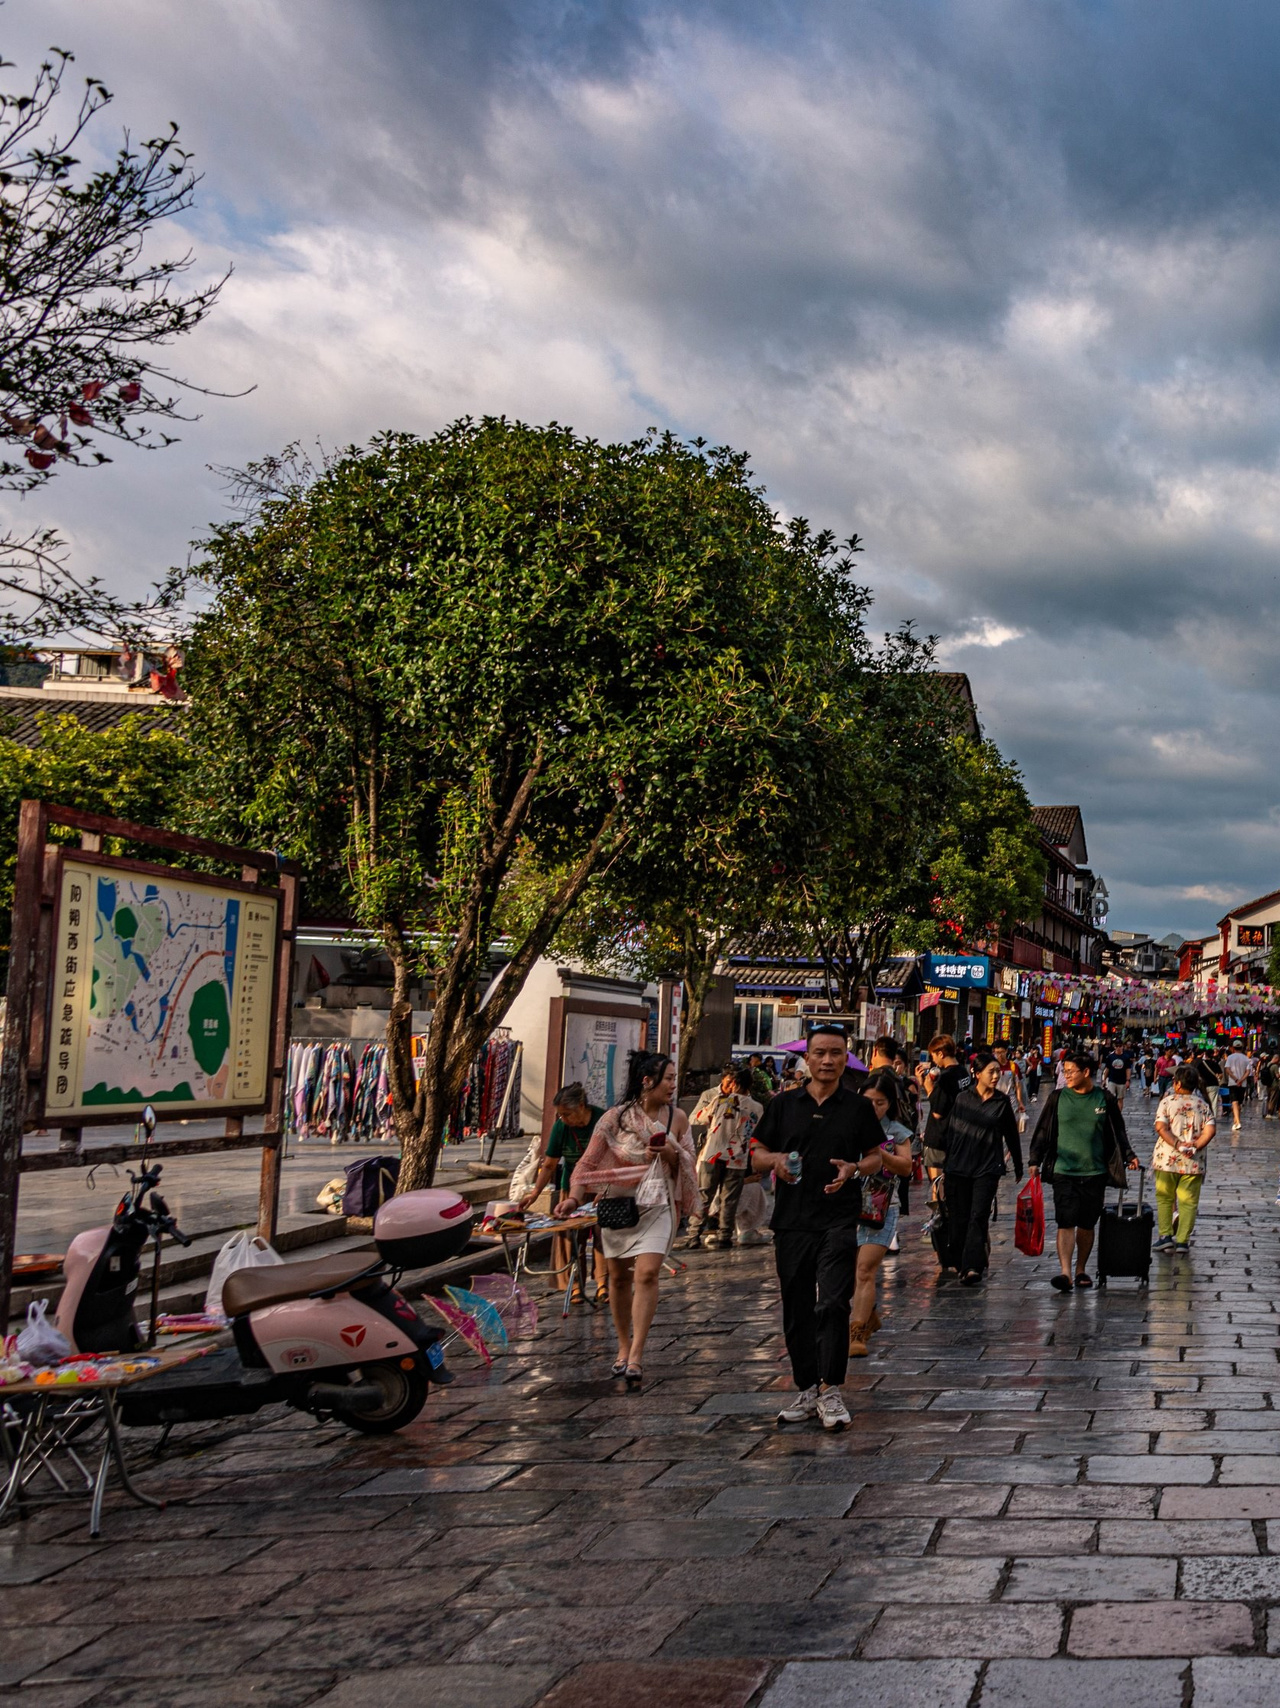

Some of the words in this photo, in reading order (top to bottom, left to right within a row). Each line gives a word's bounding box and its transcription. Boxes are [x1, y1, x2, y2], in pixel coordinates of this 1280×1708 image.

[54, 884, 83, 1095] 阳朔西街应急疏导图
